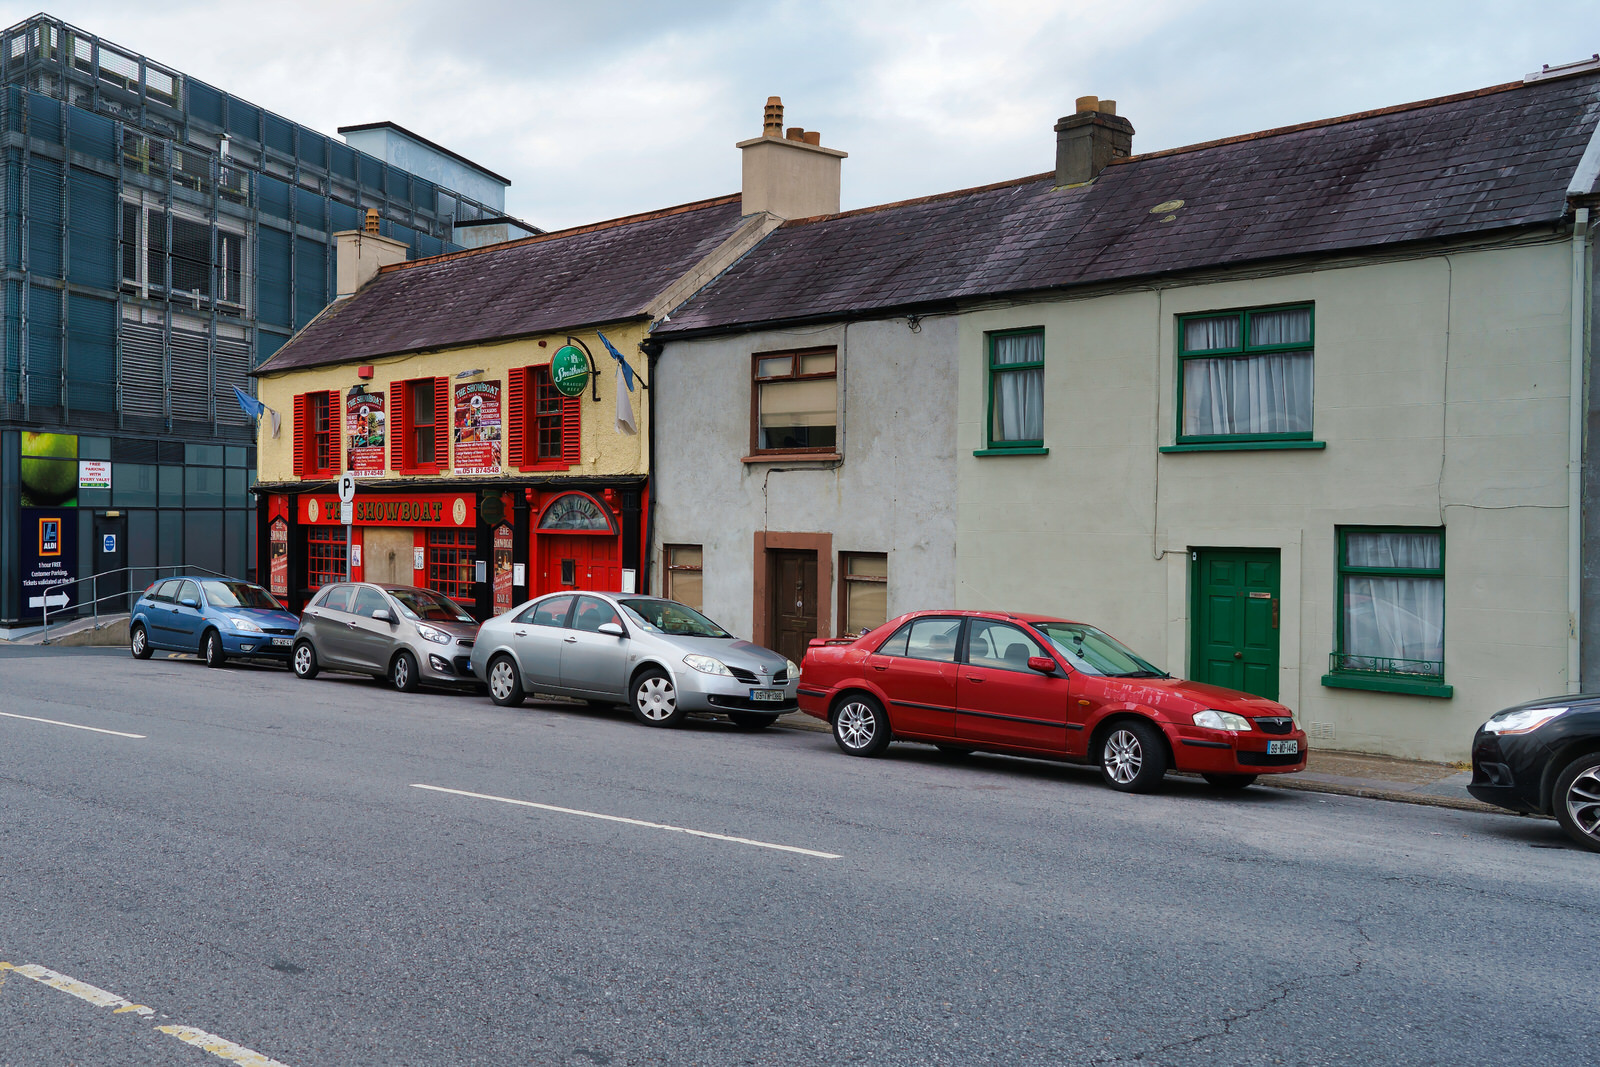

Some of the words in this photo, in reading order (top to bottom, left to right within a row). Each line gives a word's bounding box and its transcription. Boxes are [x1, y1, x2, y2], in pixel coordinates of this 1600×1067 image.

[456, 387, 466, 400] THE
[467, 382, 499, 396] SHOWBOAT
[344, 478, 350, 497] P
[325, 502, 341, 520] TH
[357, 501, 442, 522] SHOWBOAT
[553, 499, 598, 520] SALOON
